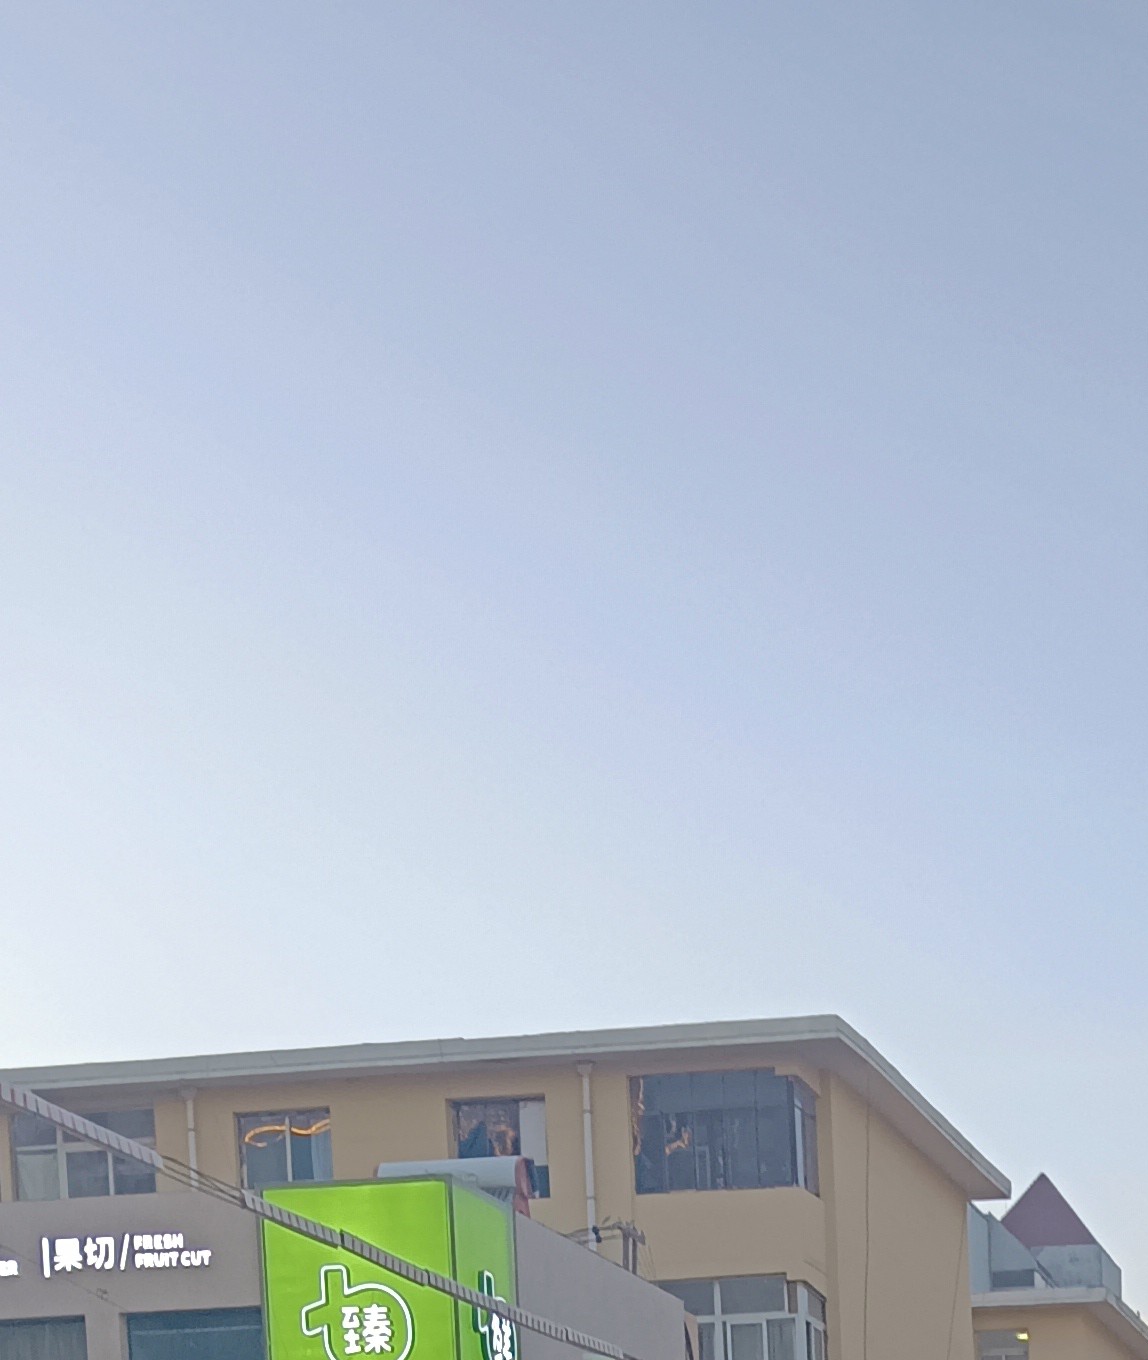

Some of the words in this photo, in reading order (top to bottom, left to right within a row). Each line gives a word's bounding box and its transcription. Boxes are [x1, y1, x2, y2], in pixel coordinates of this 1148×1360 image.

[133, 1233, 184, 1250] FRESH
[134, 1251, 179, 1269] FRUIT
[180, 1249, 212, 1267] CUT
[341, 1303, 393, 1355] 臻
